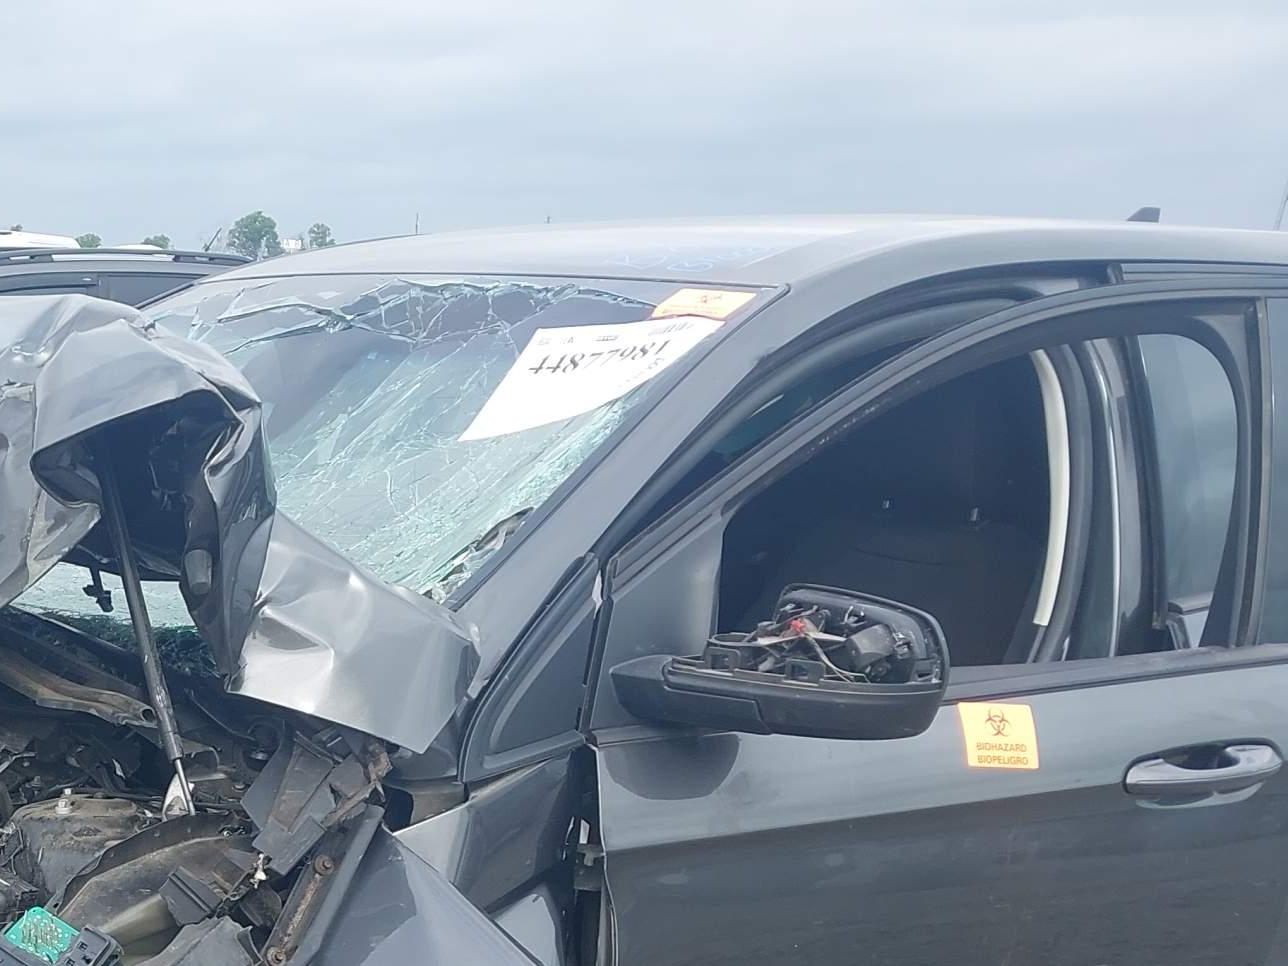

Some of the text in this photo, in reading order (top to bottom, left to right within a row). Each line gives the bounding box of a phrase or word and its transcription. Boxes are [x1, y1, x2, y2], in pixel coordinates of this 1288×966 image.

[528, 339, 671, 375] 44877981
[976, 742, 1028, 753] BIOHAZARD
[977, 754, 1029, 765] BIOPELIGRO
